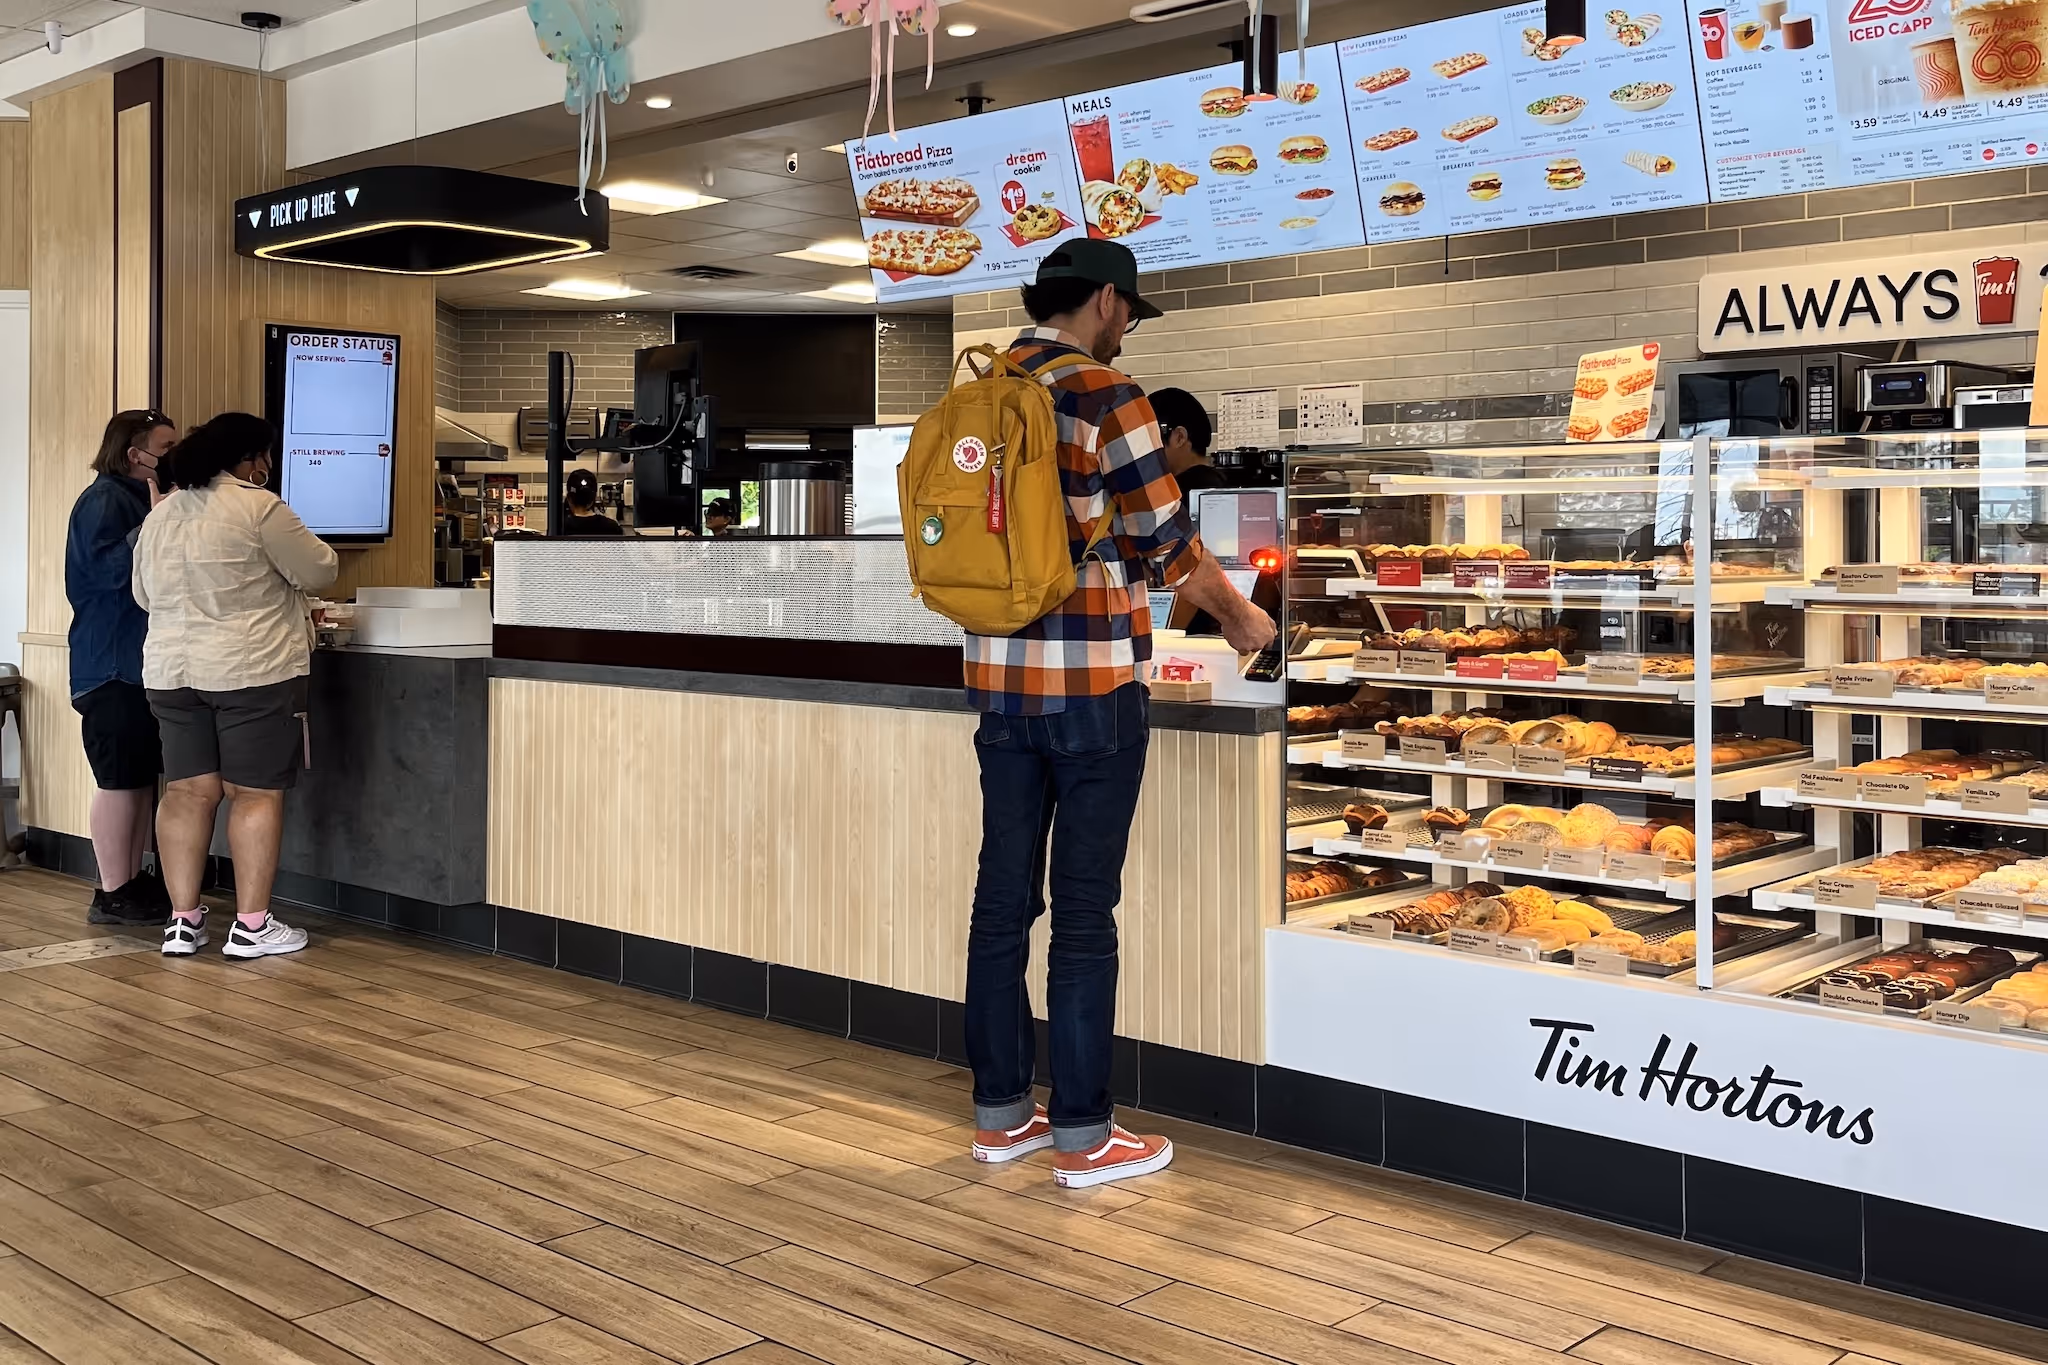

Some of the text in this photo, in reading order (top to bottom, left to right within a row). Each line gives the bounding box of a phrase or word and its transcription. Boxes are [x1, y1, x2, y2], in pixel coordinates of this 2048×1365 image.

[1504, 10, 1528, 19] LOADED
[1850, 17, 1932, 42] ICED CAPP
[1968, 16, 2041, 37] Tim Hortons
[1356, 38, 1386, 49] FLATBREAD
[1388, 34, 1408, 43] PIZZAS
[1972, 36, 2042, 84] 60
[1721, 63, 1762, 75] BEVERAGES
[1878, 76, 1910, 86] ORIGINAL
[1072, 96, 1112, 115] MEALS
[1992, 97, 2022, 109] $4.49
[1918, 108, 1947, 120] $4.49
[1850, 118, 1877, 130] $3.59
[853, 145, 866, 154] NEW
[855, 143, 952, 171] Flatbread Pizza
[1006, 151, 1046, 166] dream
[1716, 156, 1752, 164] CUSTOMIZE
[1773, 148, 1806, 157] BEVERAGE
[1014, 164, 1040, 176] cookie
[1442, 162, 1475, 171] BREAKFAST
[1362, 173, 1396, 183] CRAVEABLES
[270, 191, 336, 227] PICK UP HERE
[1976, 272, 2003, 296] Tim
[1714, 268, 1960, 336] ALWAYS
[290, 335, 394, 351] ORDER STATUS
[1580, 355, 1617, 370] Flatbread
[1835, 675, 1852, 683] Apple
[1990, 683, 2010, 692] Honey
[1812, 775, 1843, 783] Fashioned
[1865, 780, 1910, 792] Chocolate Dip
[1965, 788, 2000, 799] Vanilla Dip
[1497, 846, 1523, 856] Everything
[1818, 886, 1840, 894] Glazed
[1960, 899, 2019, 912] Chocolate Glazed
[1473, 934, 1490, 943] Asiago
[1823, 992, 1878, 1006] Double Chocolate
[1936, 1010, 1970, 1022] Honey Dip
[1530, 1018, 1874, 1145] Tim Hortons
